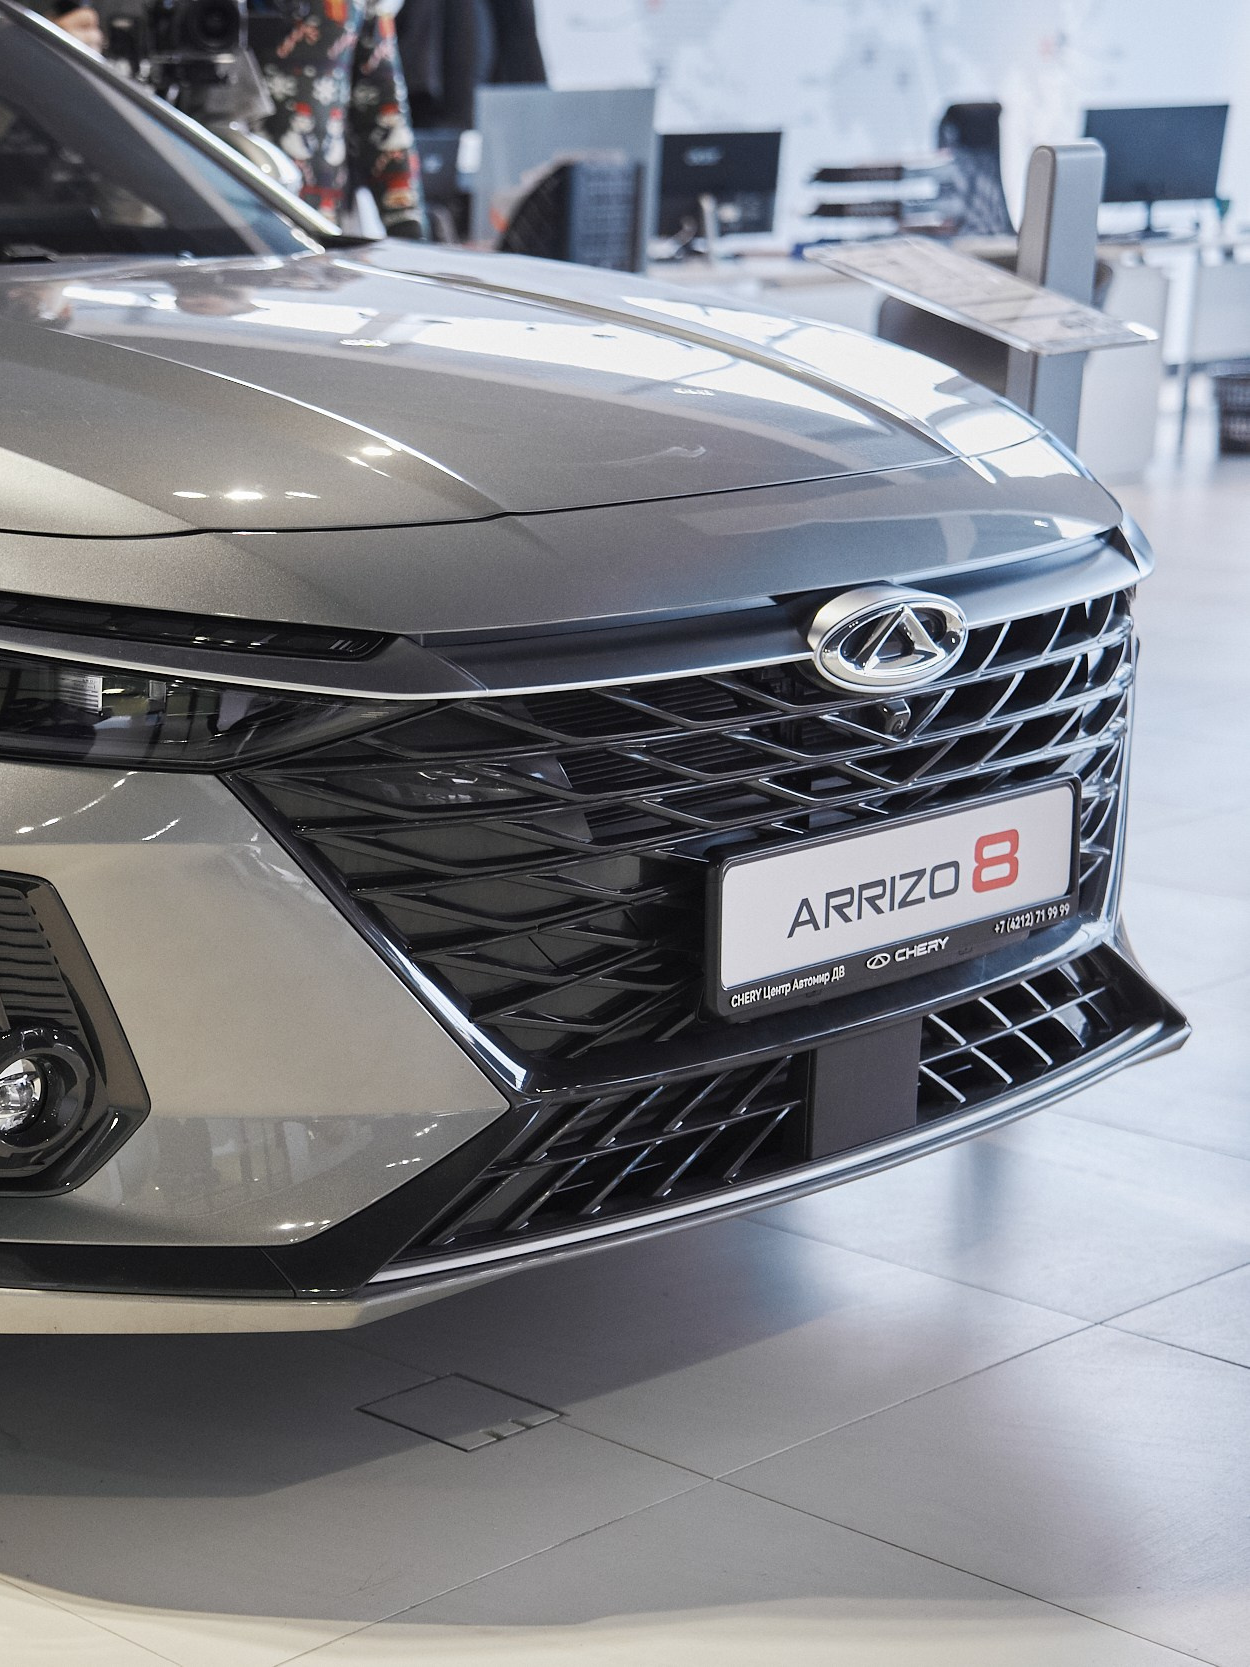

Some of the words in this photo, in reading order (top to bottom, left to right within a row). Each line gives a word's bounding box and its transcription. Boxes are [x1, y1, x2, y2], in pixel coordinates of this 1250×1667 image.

[787, 860, 960, 939] ARRIZO
[972, 828, 1019, 893] 8
[994, 920, 1006, 934] +7
[1006, 911, 1034, 933] (4212)
[1035, 908, 1046, 924] 71
[1047, 905, 1058, 920] 99
[1059, 902, 1070, 916] 99
[895, 936, 949, 963] CHERY
[731, 988, 762, 1008] CHERY
[763, 982, 791, 1001] Центр
[792, 972, 830, 992] Автомир
[831, 965, 845, 982] ДВ
